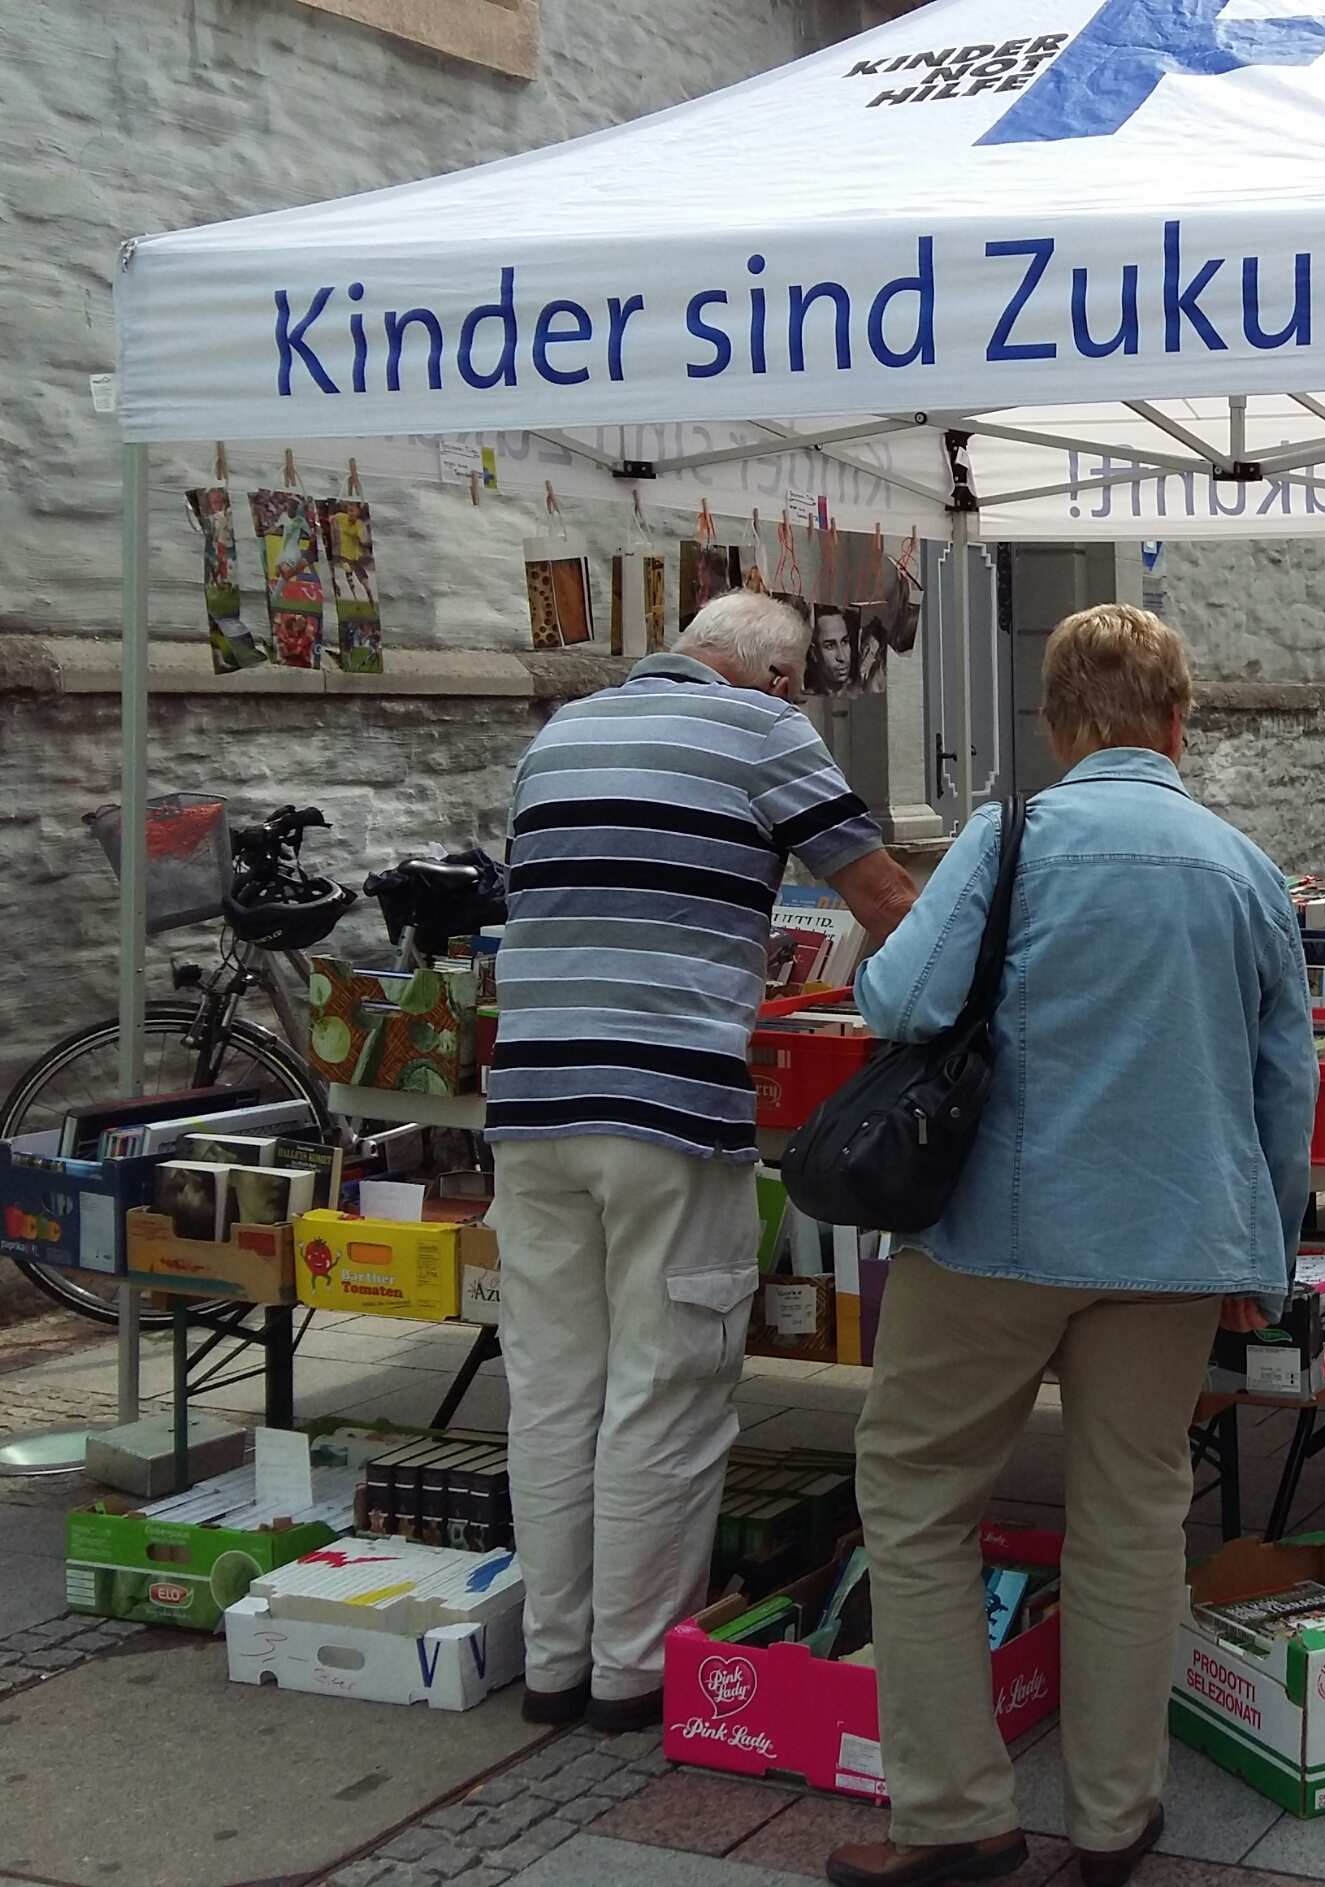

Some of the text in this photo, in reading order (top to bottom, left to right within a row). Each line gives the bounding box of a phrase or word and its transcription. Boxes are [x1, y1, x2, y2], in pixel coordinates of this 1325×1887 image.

[842, 33, 1069, 78] KINDER
[920, 52, 1057, 85] NOT
[865, 72, 1037, 108] HILFE
[274, 265, 645, 396] Kinder
[686, 235, 935, 379] sind
[342, 1281, 403, 1299] Tomaten
[704, 1665, 743, 1691] Pink
[714, 1682, 751, 1703] Lady
[1193, 1649, 1256, 1703] PRODOTTI
[1186, 1667, 1261, 1730] SELEZIONATI
[670, 1717, 778, 1759] Pink Lady
